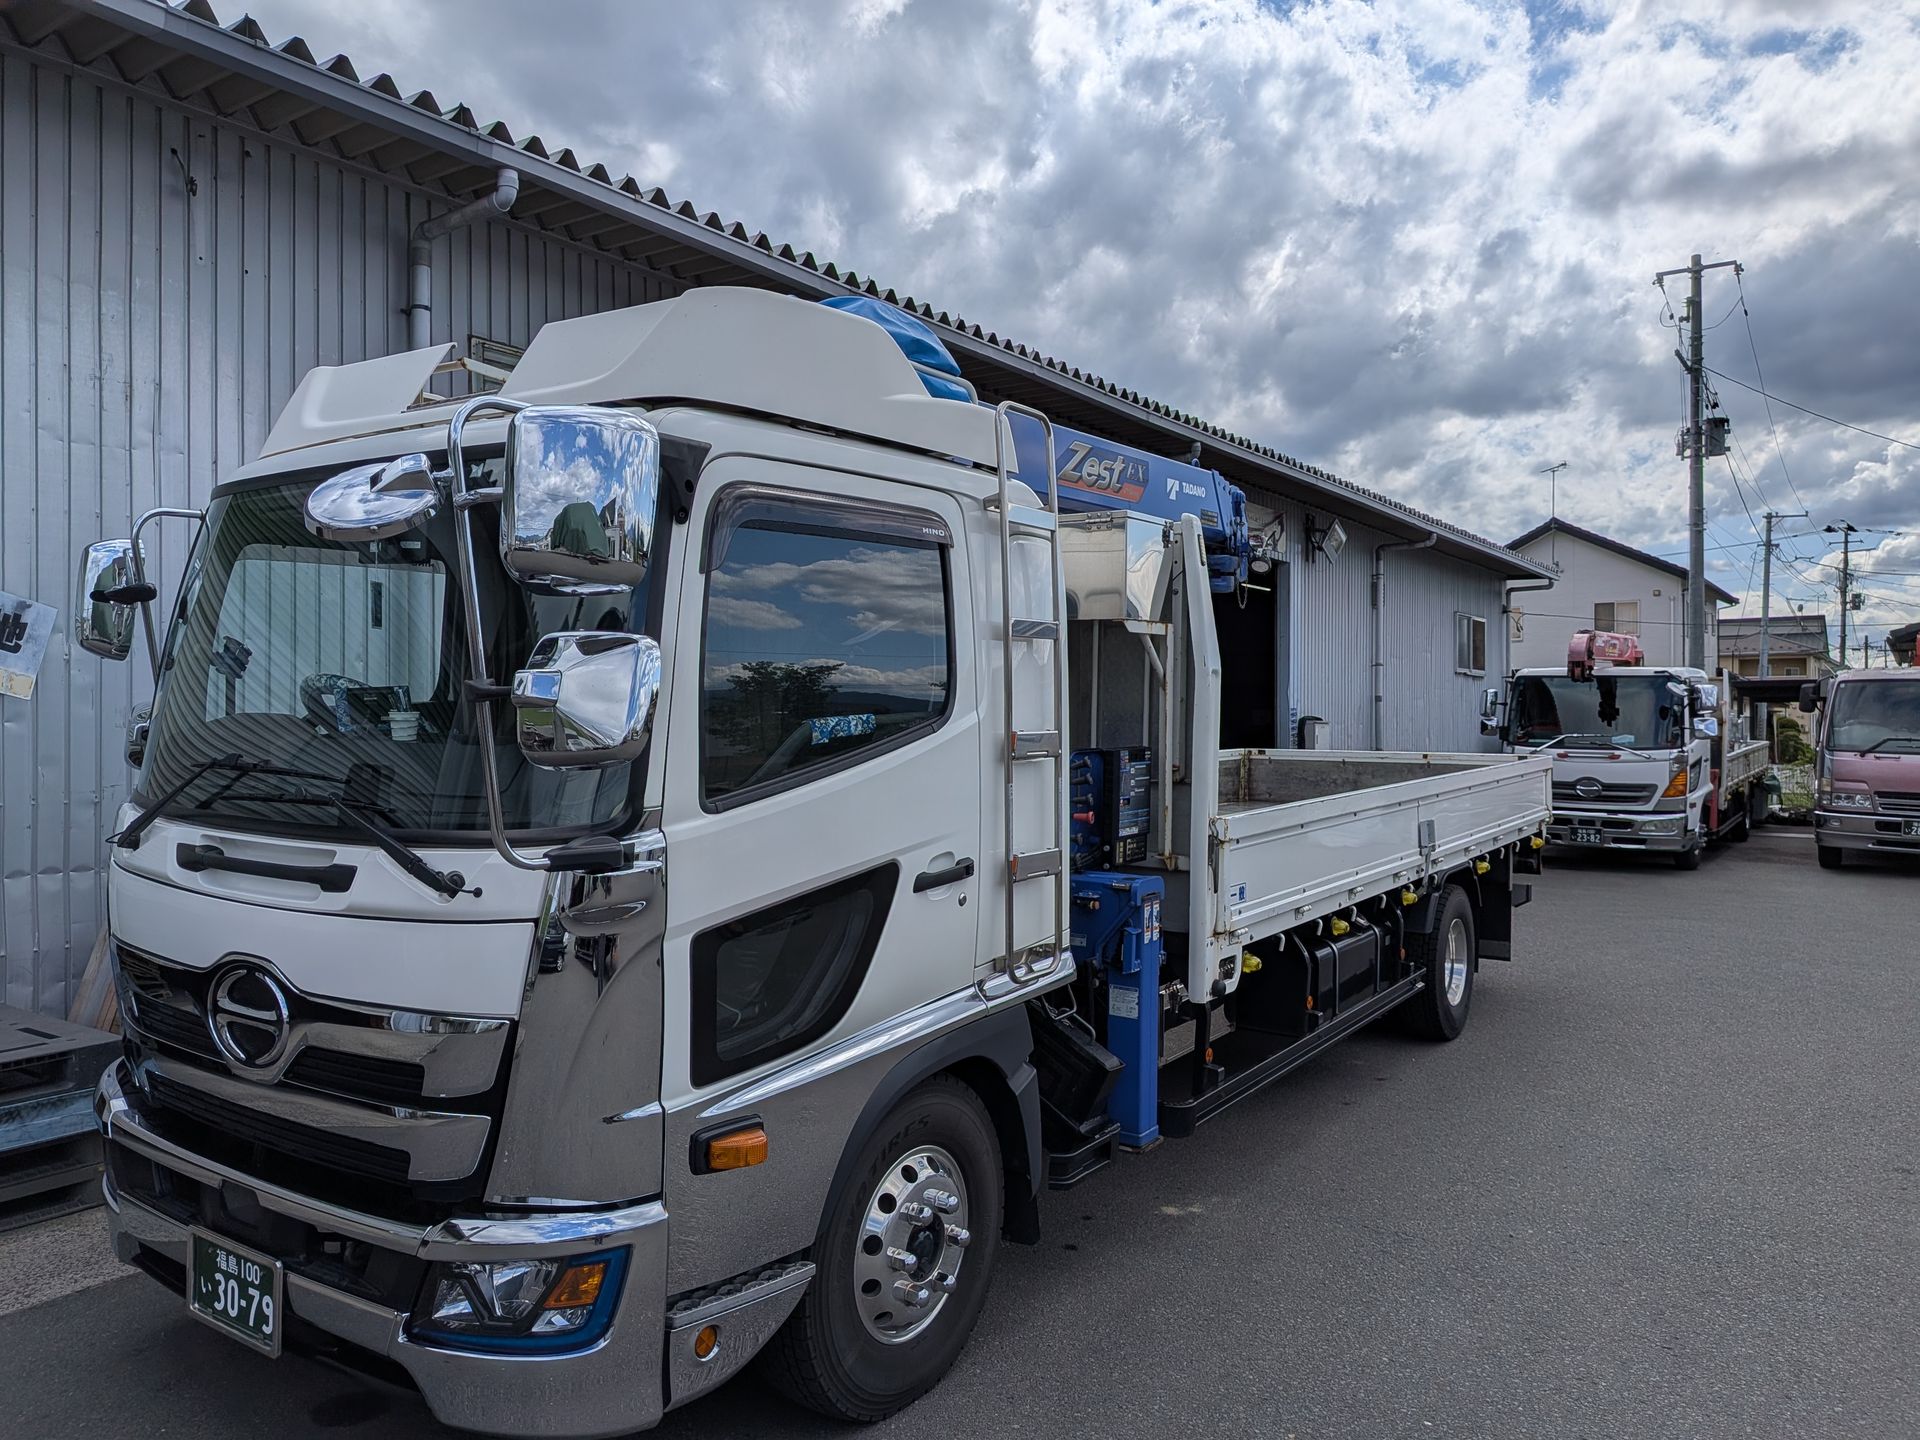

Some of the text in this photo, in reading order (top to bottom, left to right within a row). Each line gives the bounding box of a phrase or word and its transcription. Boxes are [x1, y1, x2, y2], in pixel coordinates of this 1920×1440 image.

[1057, 440, 1147, 493] Zest EX
[1182, 481, 1206, 499] TADANO
[922, 526, 945, 537] HINO
[215, 1248, 260, 1285] 福島 100
[200, 1272, 274, 1335] い 30-79
